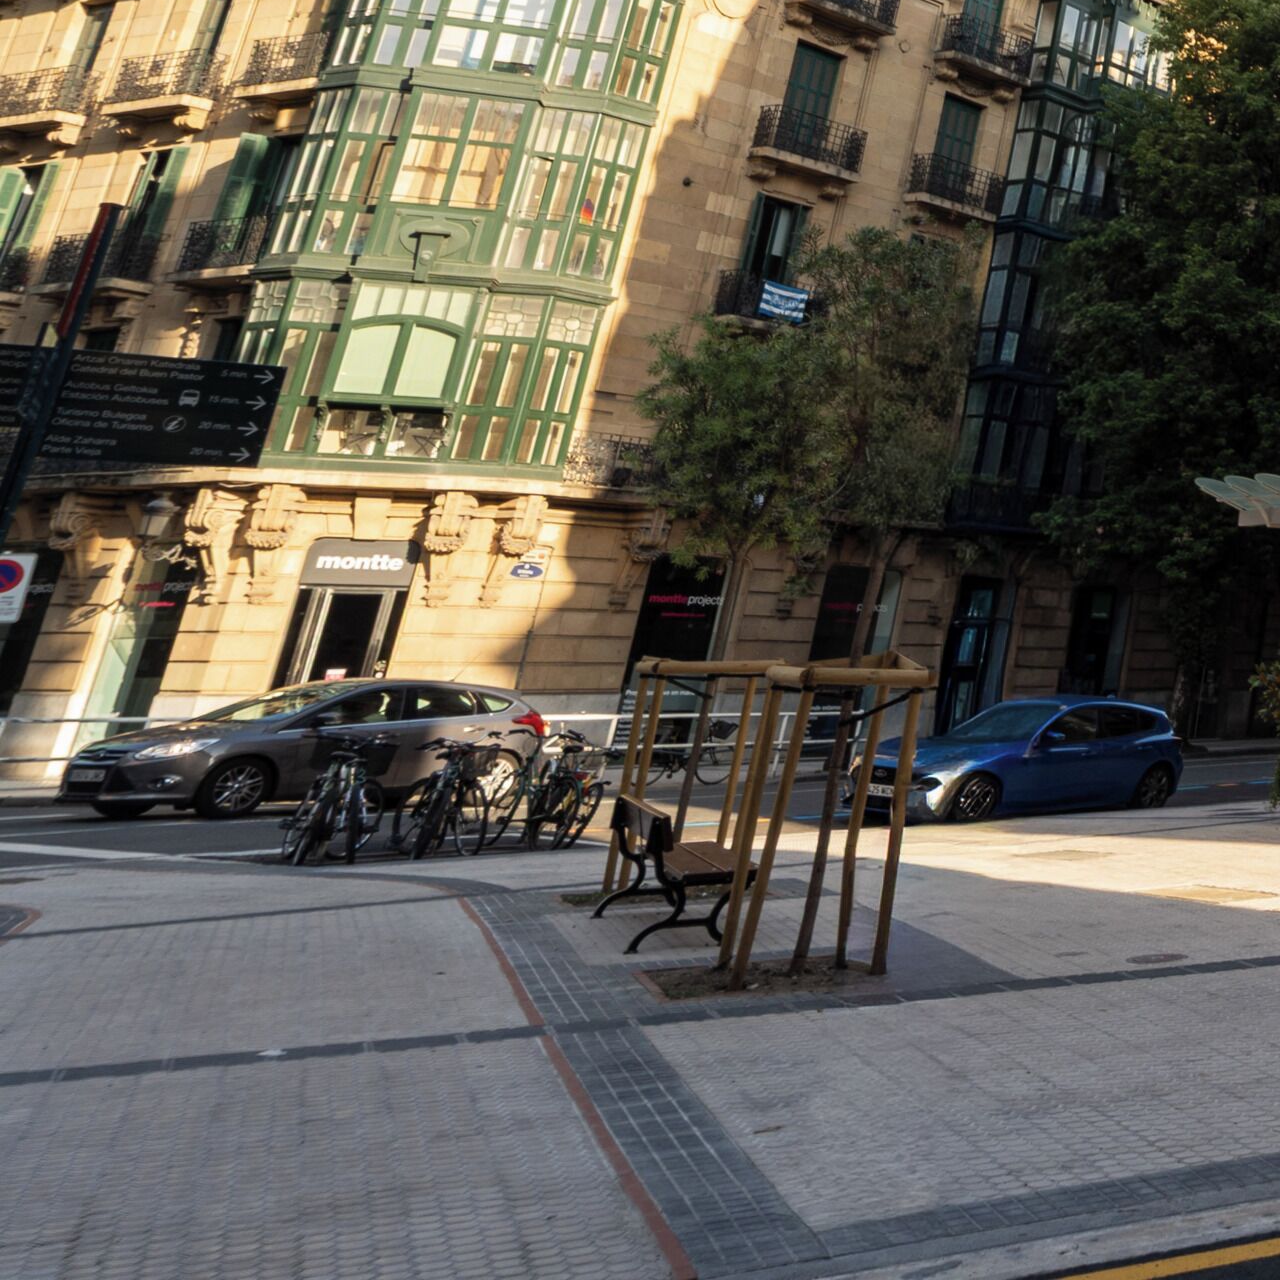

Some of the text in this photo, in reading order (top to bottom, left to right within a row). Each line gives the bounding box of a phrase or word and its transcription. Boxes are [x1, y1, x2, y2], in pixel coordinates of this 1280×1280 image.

[70, 364, 206, 381] Catedral del Buen Pastor
[63, 380, 111, 391] Autobus
[111, 394, 169, 405] Autobuses
[56, 406, 100, 417] Turismo
[51, 417, 154, 432] Oficina de Turismo
[73, 436, 118, 446] Zaharra
[42, 444, 102, 456] Parte Vieja
[316, 554, 404, 571] montte
